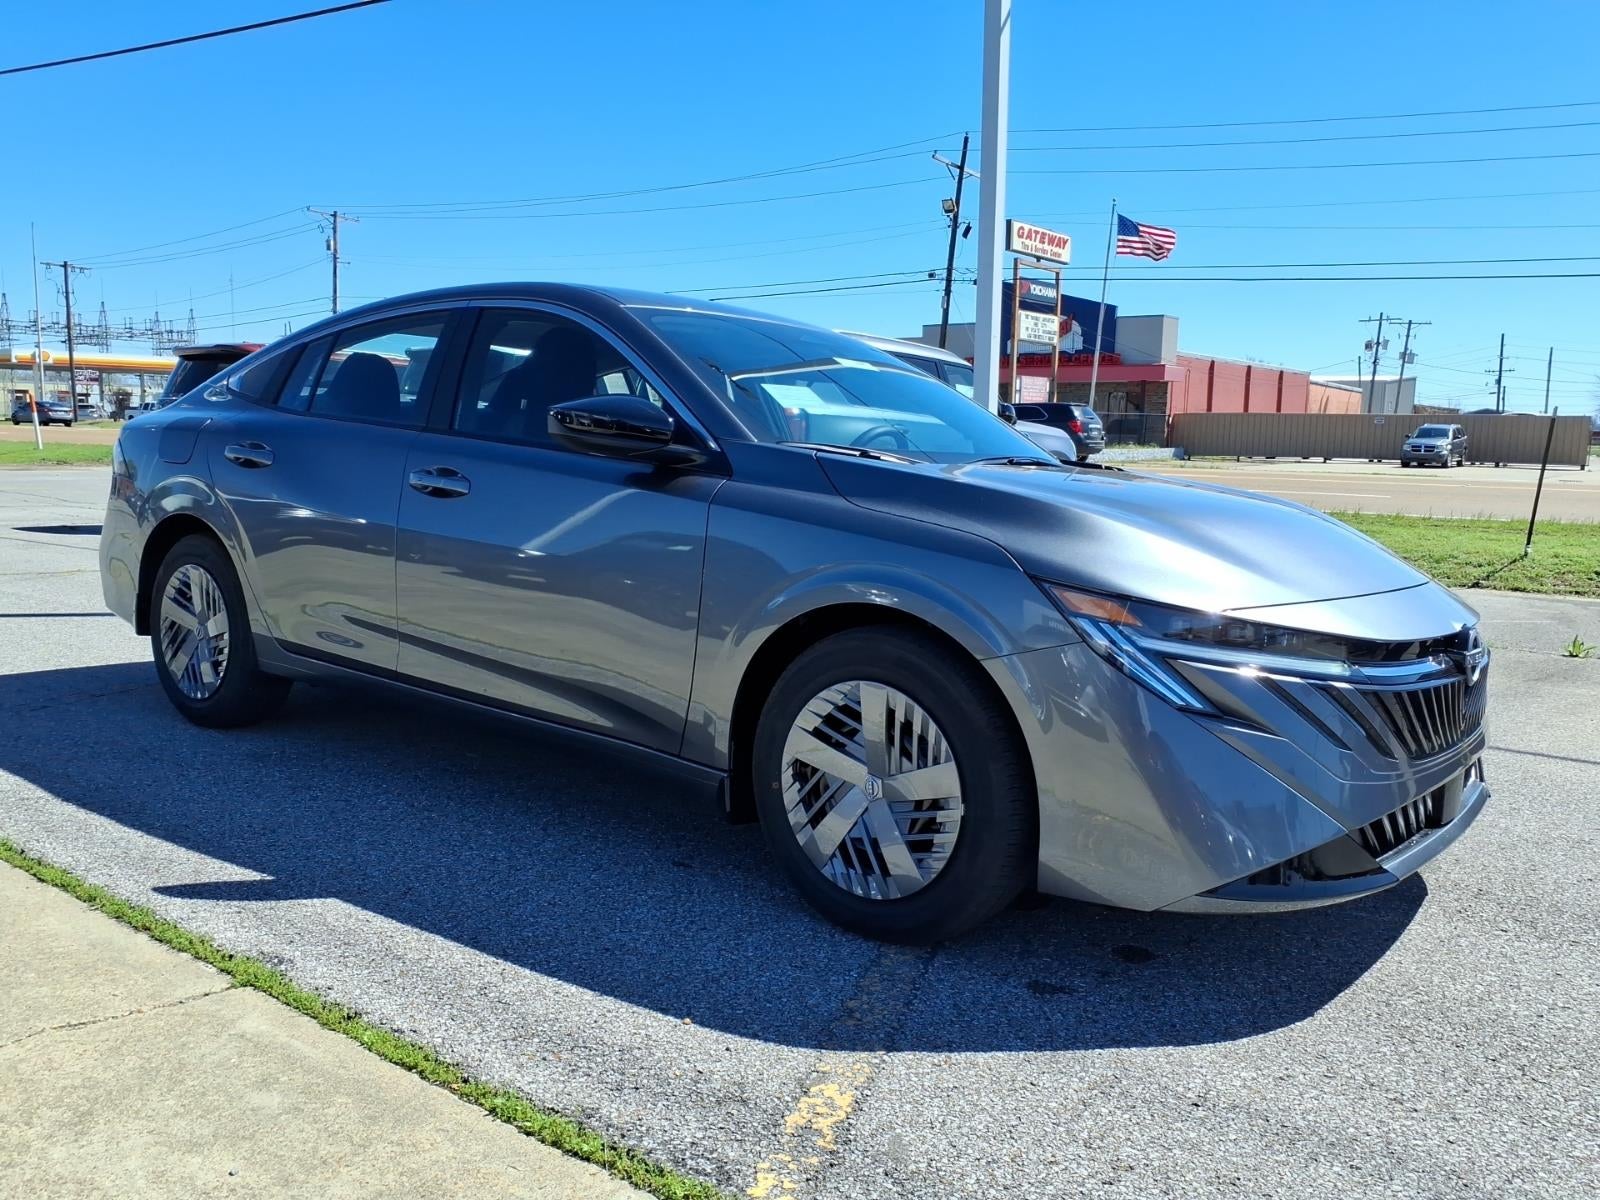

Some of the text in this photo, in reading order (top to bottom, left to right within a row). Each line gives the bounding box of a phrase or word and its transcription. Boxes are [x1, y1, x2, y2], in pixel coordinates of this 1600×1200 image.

[1017, 226, 1069, 250] GATEWAY
[1034, 245, 1049, 255] Service
[1050, 249, 1063, 259] Center
[1030, 283, 1056, 298] YOKOHAMA
